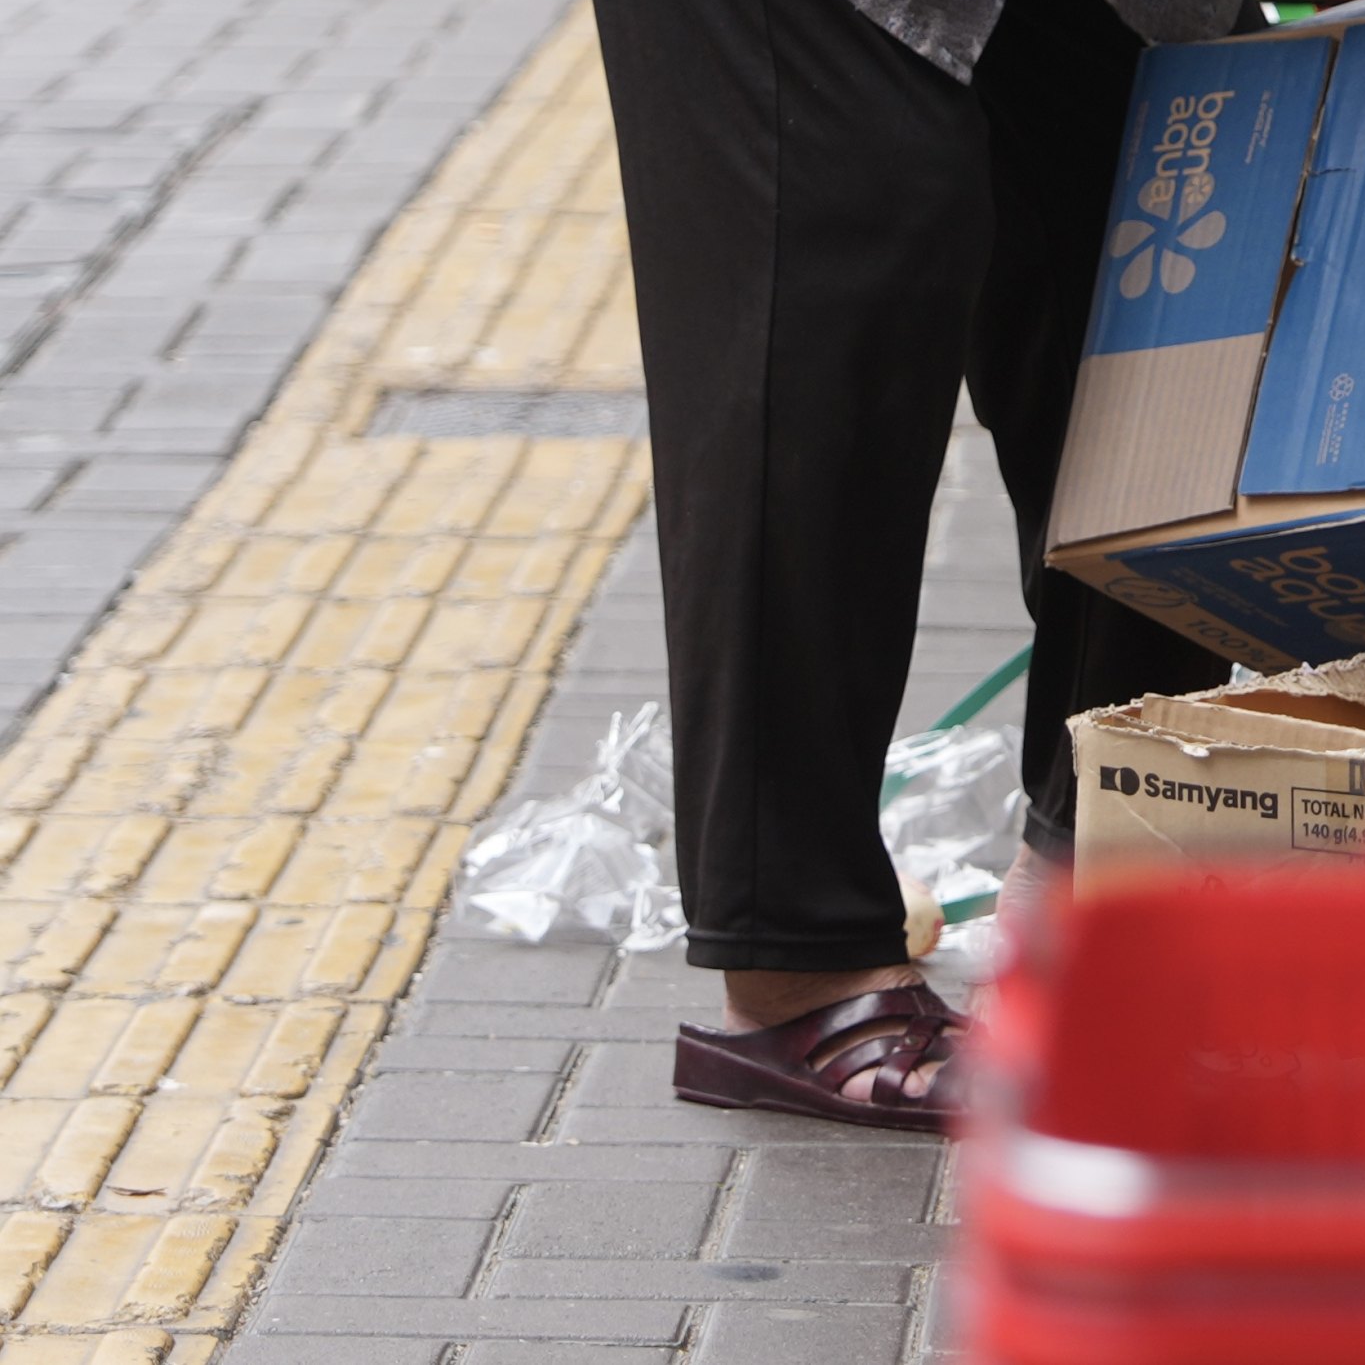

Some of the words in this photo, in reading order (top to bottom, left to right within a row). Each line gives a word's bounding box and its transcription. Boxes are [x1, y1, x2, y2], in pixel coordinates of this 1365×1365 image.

[1149, 95, 1198, 205] aqua
[1184, 91, 1235, 172] bon
[1144, 772, 1278, 820] Samyang
[1302, 798, 1350, 819] TOTAL
[1302, 822, 1329, 840] 140
